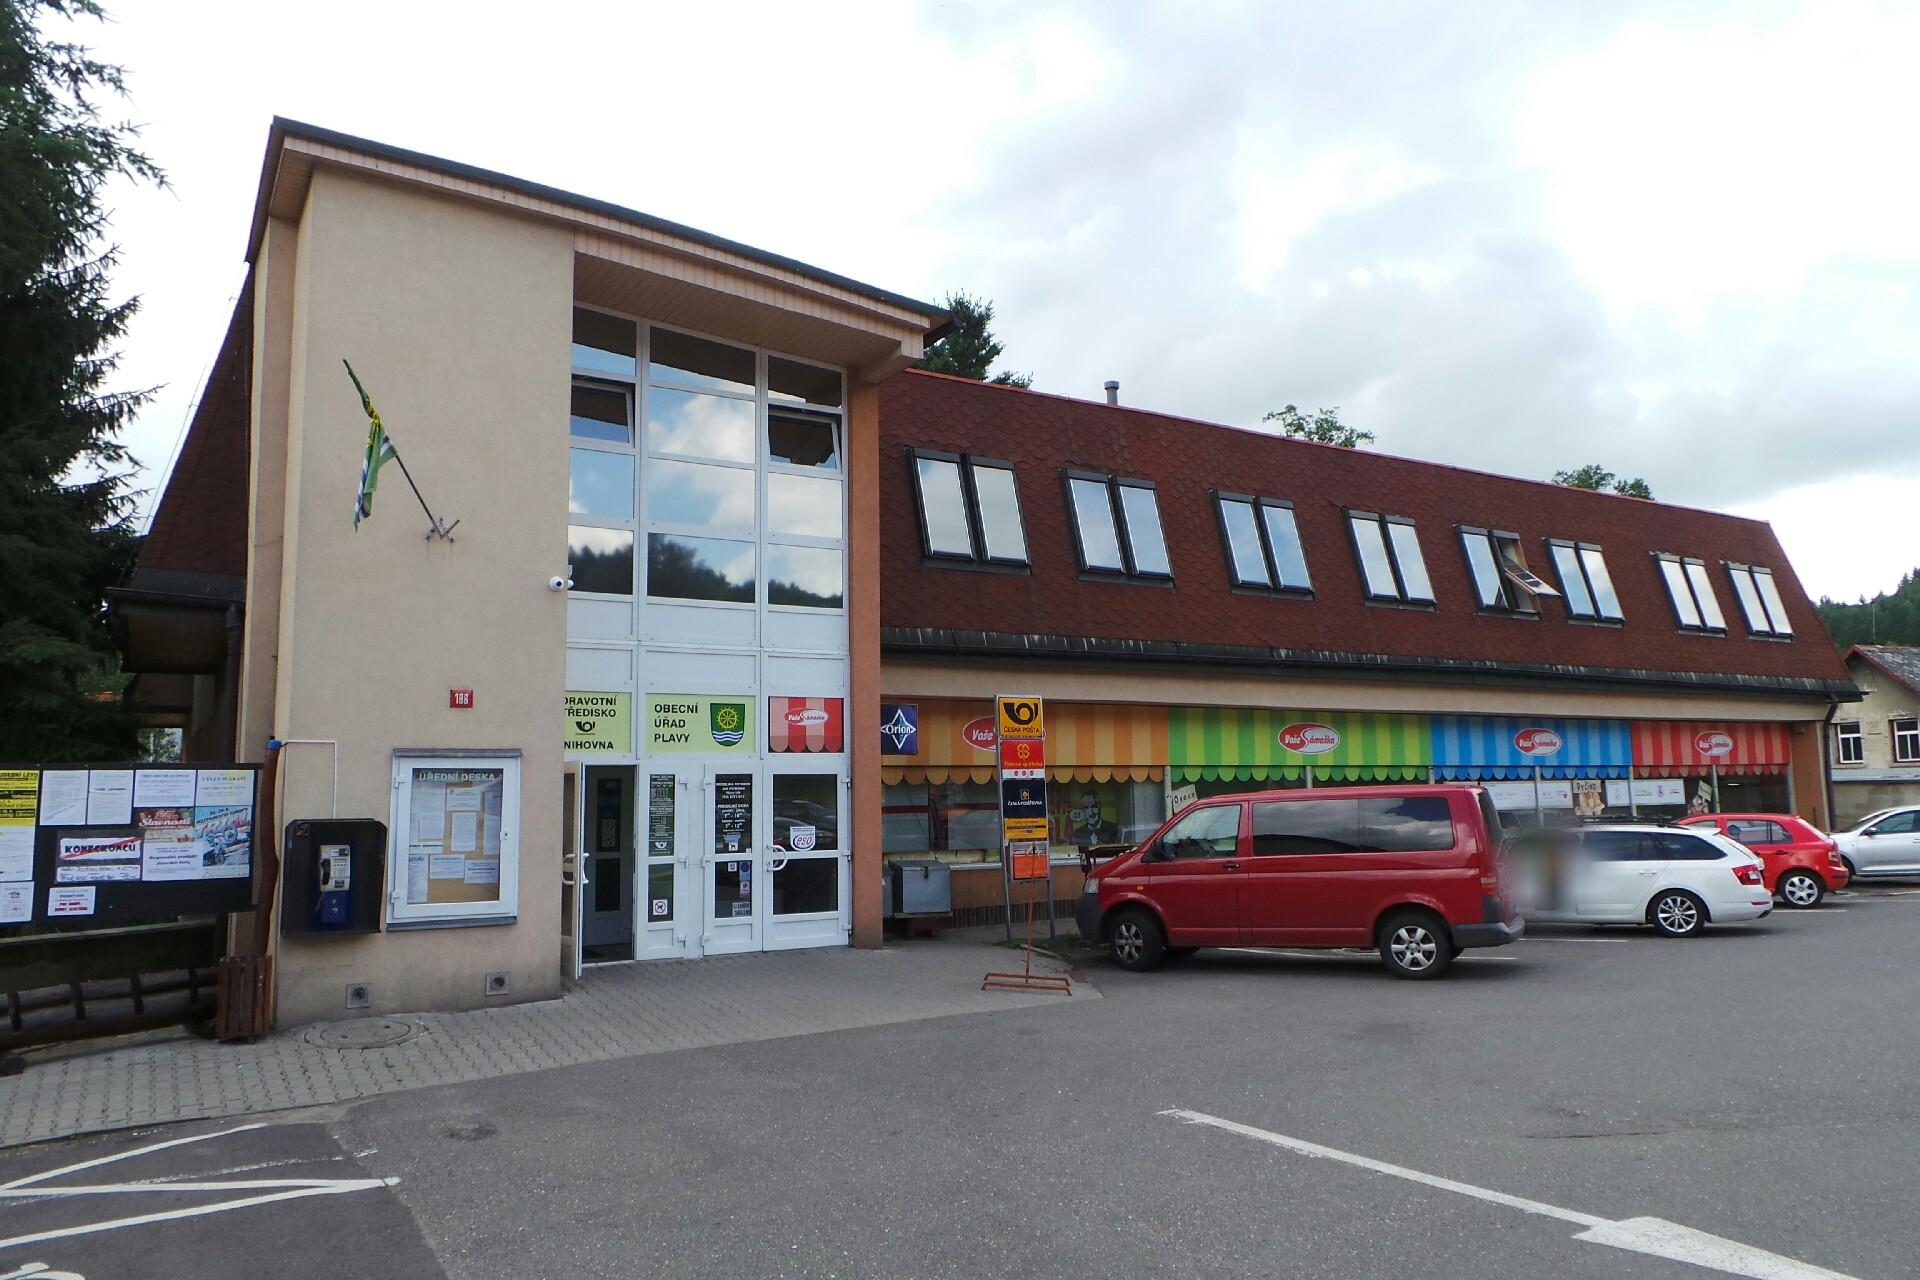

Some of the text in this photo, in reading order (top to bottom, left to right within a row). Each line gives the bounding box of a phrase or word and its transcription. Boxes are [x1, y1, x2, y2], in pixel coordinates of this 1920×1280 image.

[654, 702, 698, 714] OBECNÍ
[654, 716, 686, 728] ÚŘAD
[885, 724, 911, 735] Orion
[971, 729, 994, 741] Vaše
[654, 733, 690, 743] PLAVY
[1284, 734, 1301, 744] Vaše
[419, 771, 495, 781] ÚŘEDNÍ DESKA
